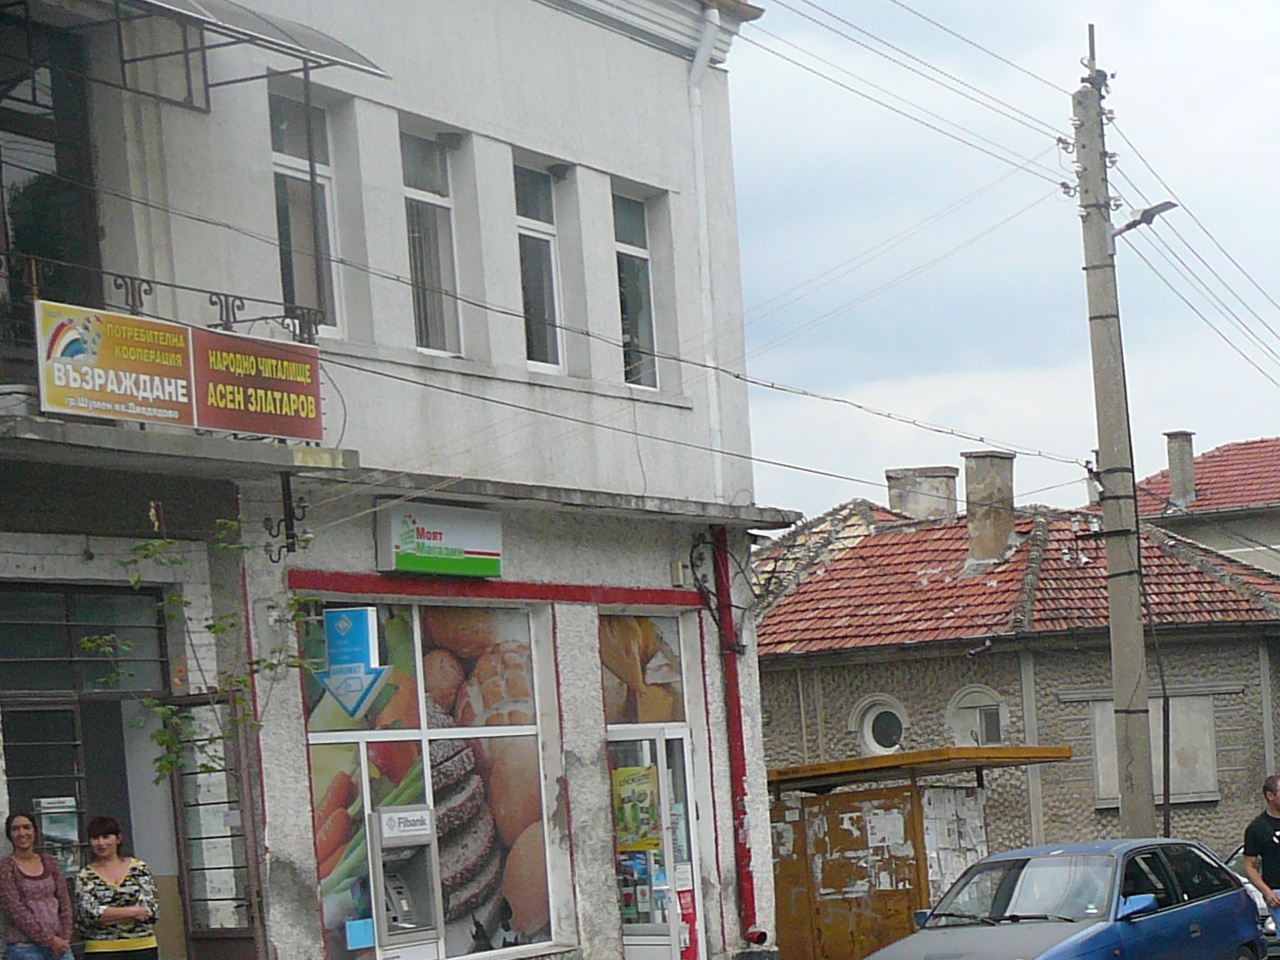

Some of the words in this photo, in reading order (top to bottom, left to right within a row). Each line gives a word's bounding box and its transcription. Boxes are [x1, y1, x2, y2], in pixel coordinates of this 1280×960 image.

[107, 323, 186, 348] ПОТРЕБИТЕЛНА
[114, 345, 183, 367] КООПЕРАЦИЯ
[208, 349, 257, 378] НАРОДНО
[258, 357, 312, 386] ЧИТАЛИЩЕ
[53, 362, 189, 403] ВЪЗРАЖДАНЕ
[207, 382, 245, 410] АСЕН
[247, 388, 317, 418] ЗЛАТАРОВ
[397, 816, 428, 829] Fibank
